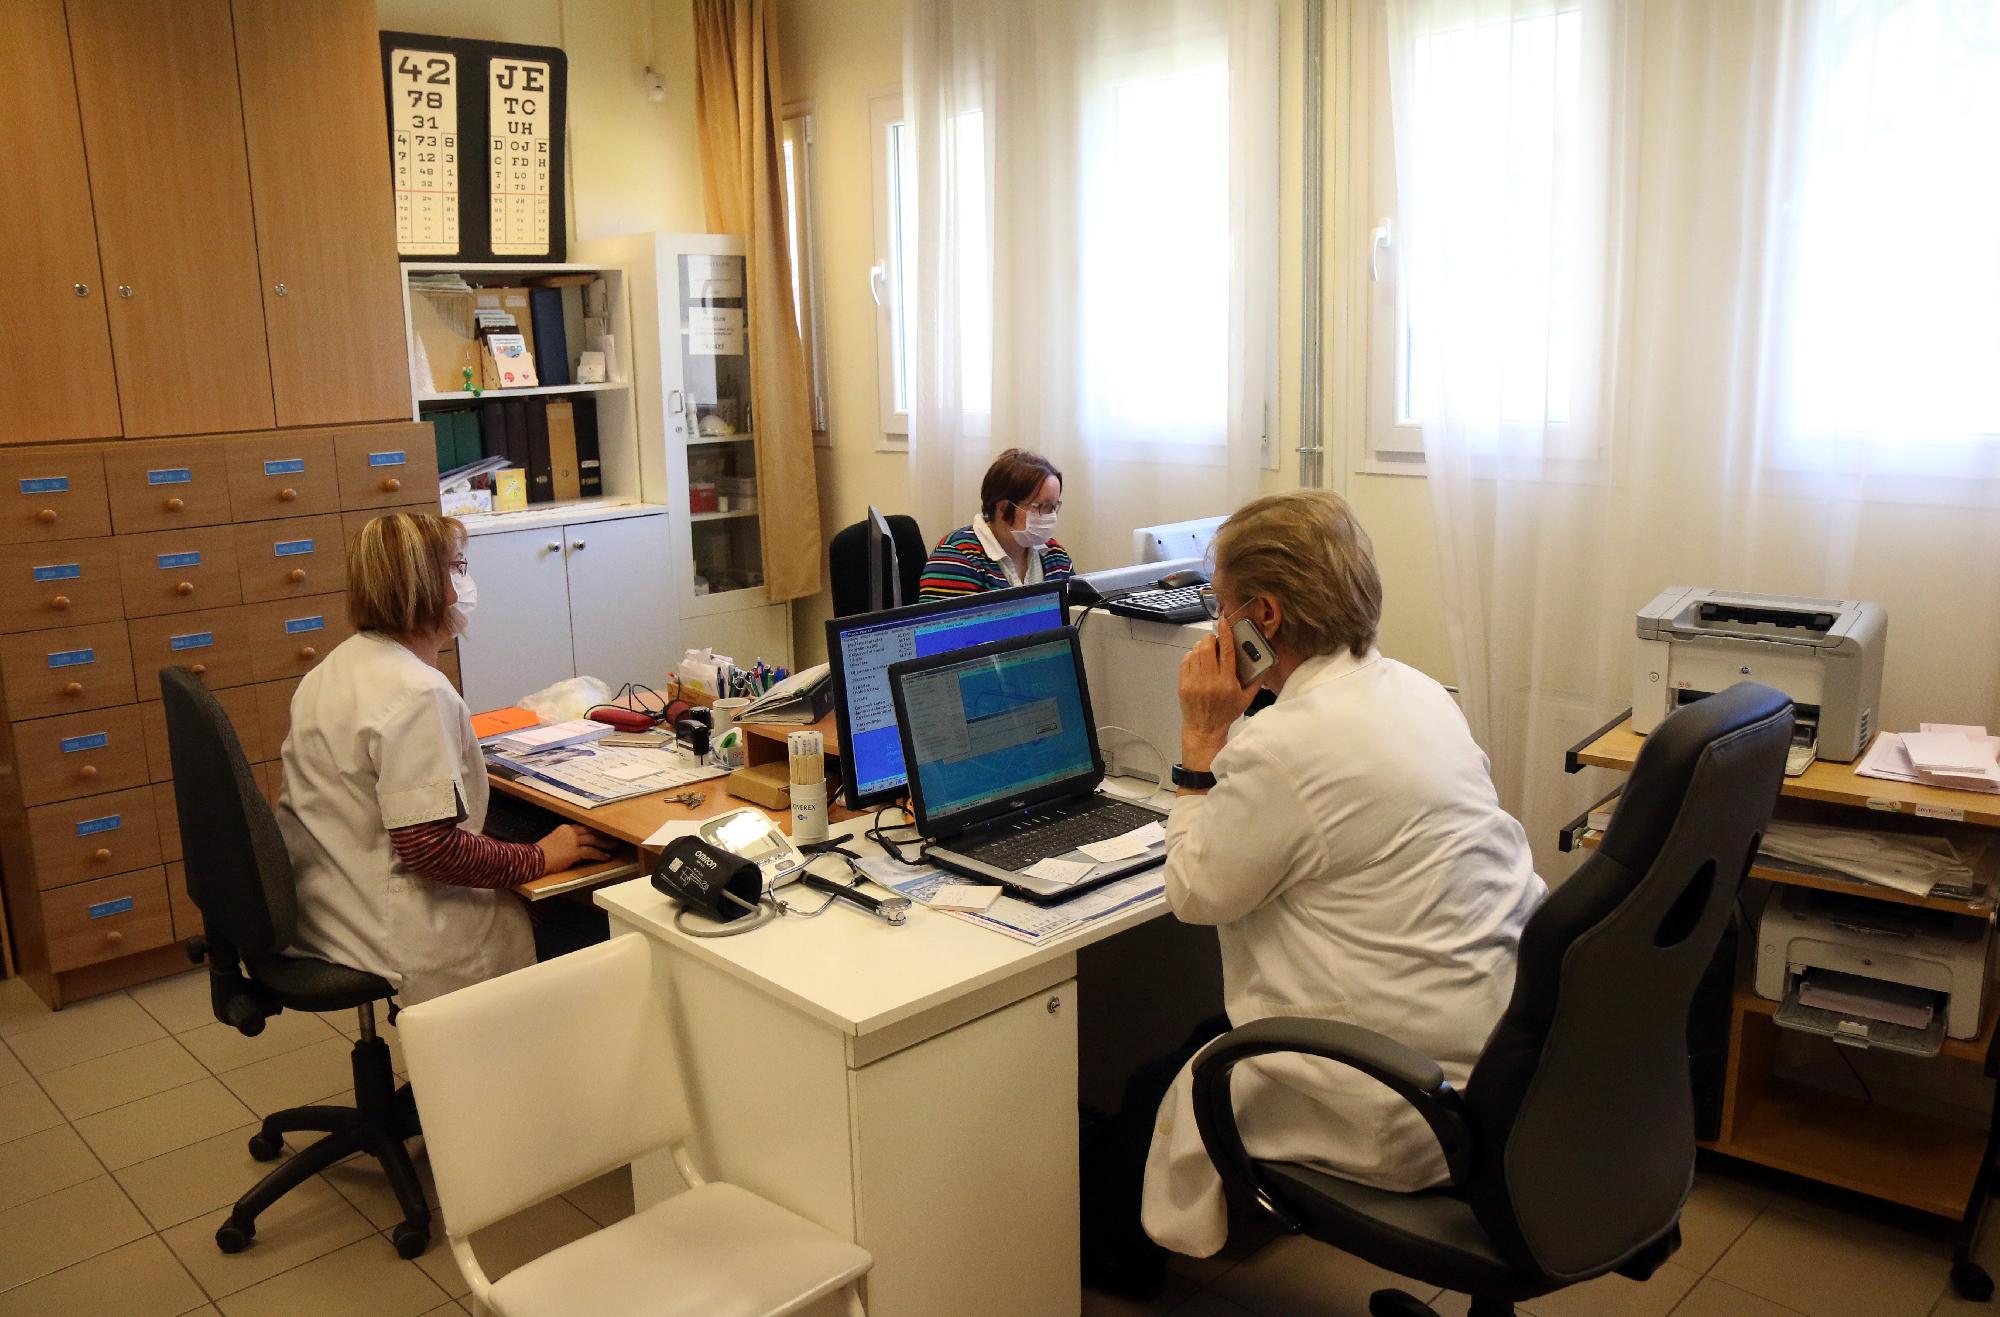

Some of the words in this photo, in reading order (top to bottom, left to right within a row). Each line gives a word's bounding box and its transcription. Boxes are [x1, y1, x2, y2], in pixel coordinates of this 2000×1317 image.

[398, 56, 451, 85] 42
[496, 65, 544, 93] JE
[407, 90, 443, 109] 78
[504, 97, 536, 115] TC
[412, 115, 439, 129] 31
[508, 121, 533, 135] UH
[397, 134, 407, 145] 4
[415, 135, 437, 146] 73
[444, 137, 454, 148] 8
[494, 140, 503, 150] D
[510, 141, 530, 152] OJ
[538, 142, 547, 153] E
[398, 151, 407, 161] 7
[417, 152, 436, 162] 12
[445, 154, 454, 163] 3
[494, 156, 502, 165] C
[512, 157, 529, 167] FD
[538, 158, 546, 167] H
[399, 166, 407, 174] 2
[419, 168, 434, 176] 48
[447, 169, 454, 177] 1
